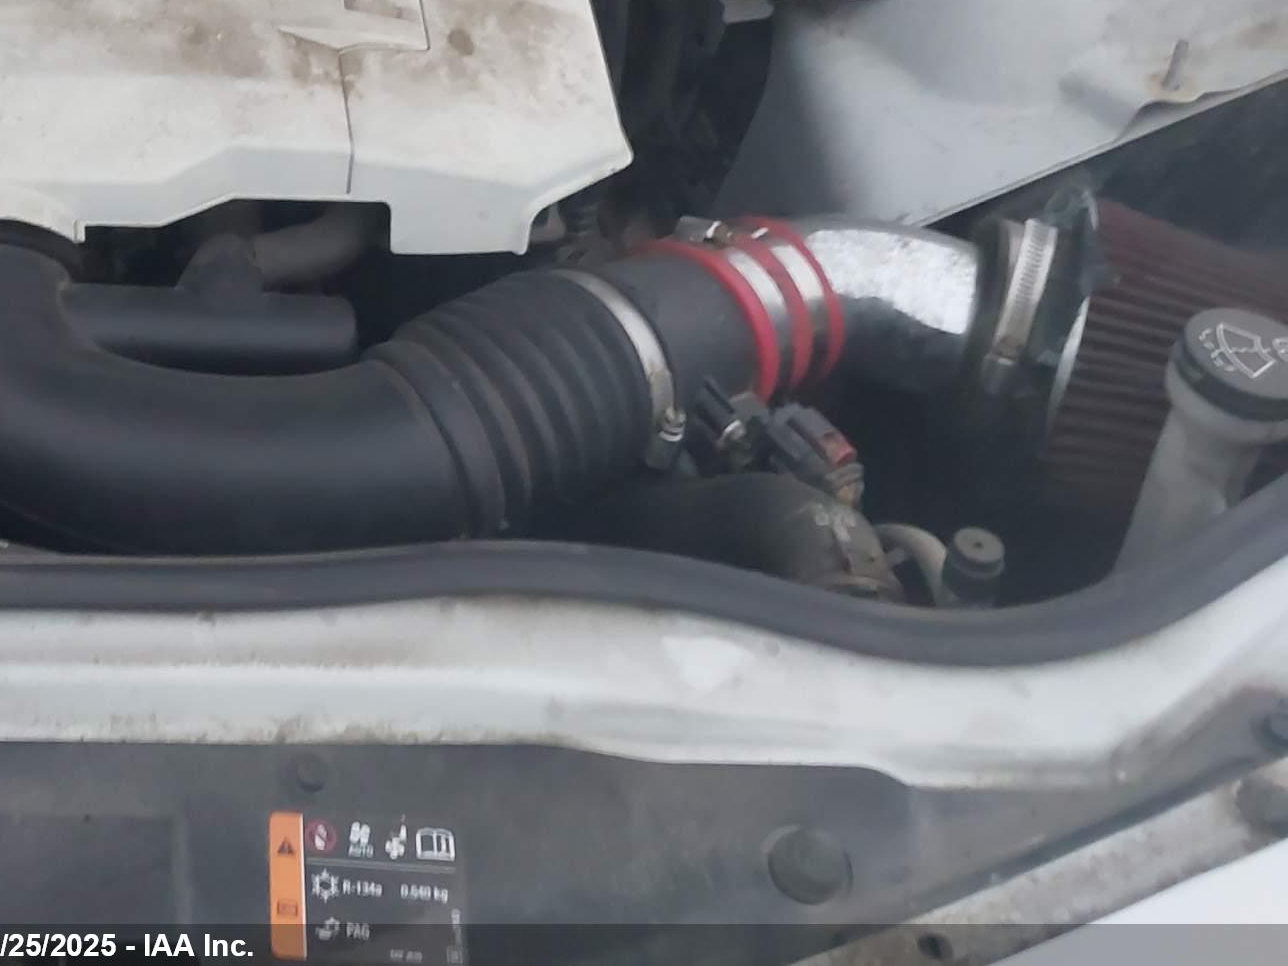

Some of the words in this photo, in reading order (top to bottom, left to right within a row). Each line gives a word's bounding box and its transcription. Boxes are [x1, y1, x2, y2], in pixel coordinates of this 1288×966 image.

[342, 878, 383, 897] R-134a
[433, 886, 449, 904] kg
[346, 922, 371, 940] PAG
